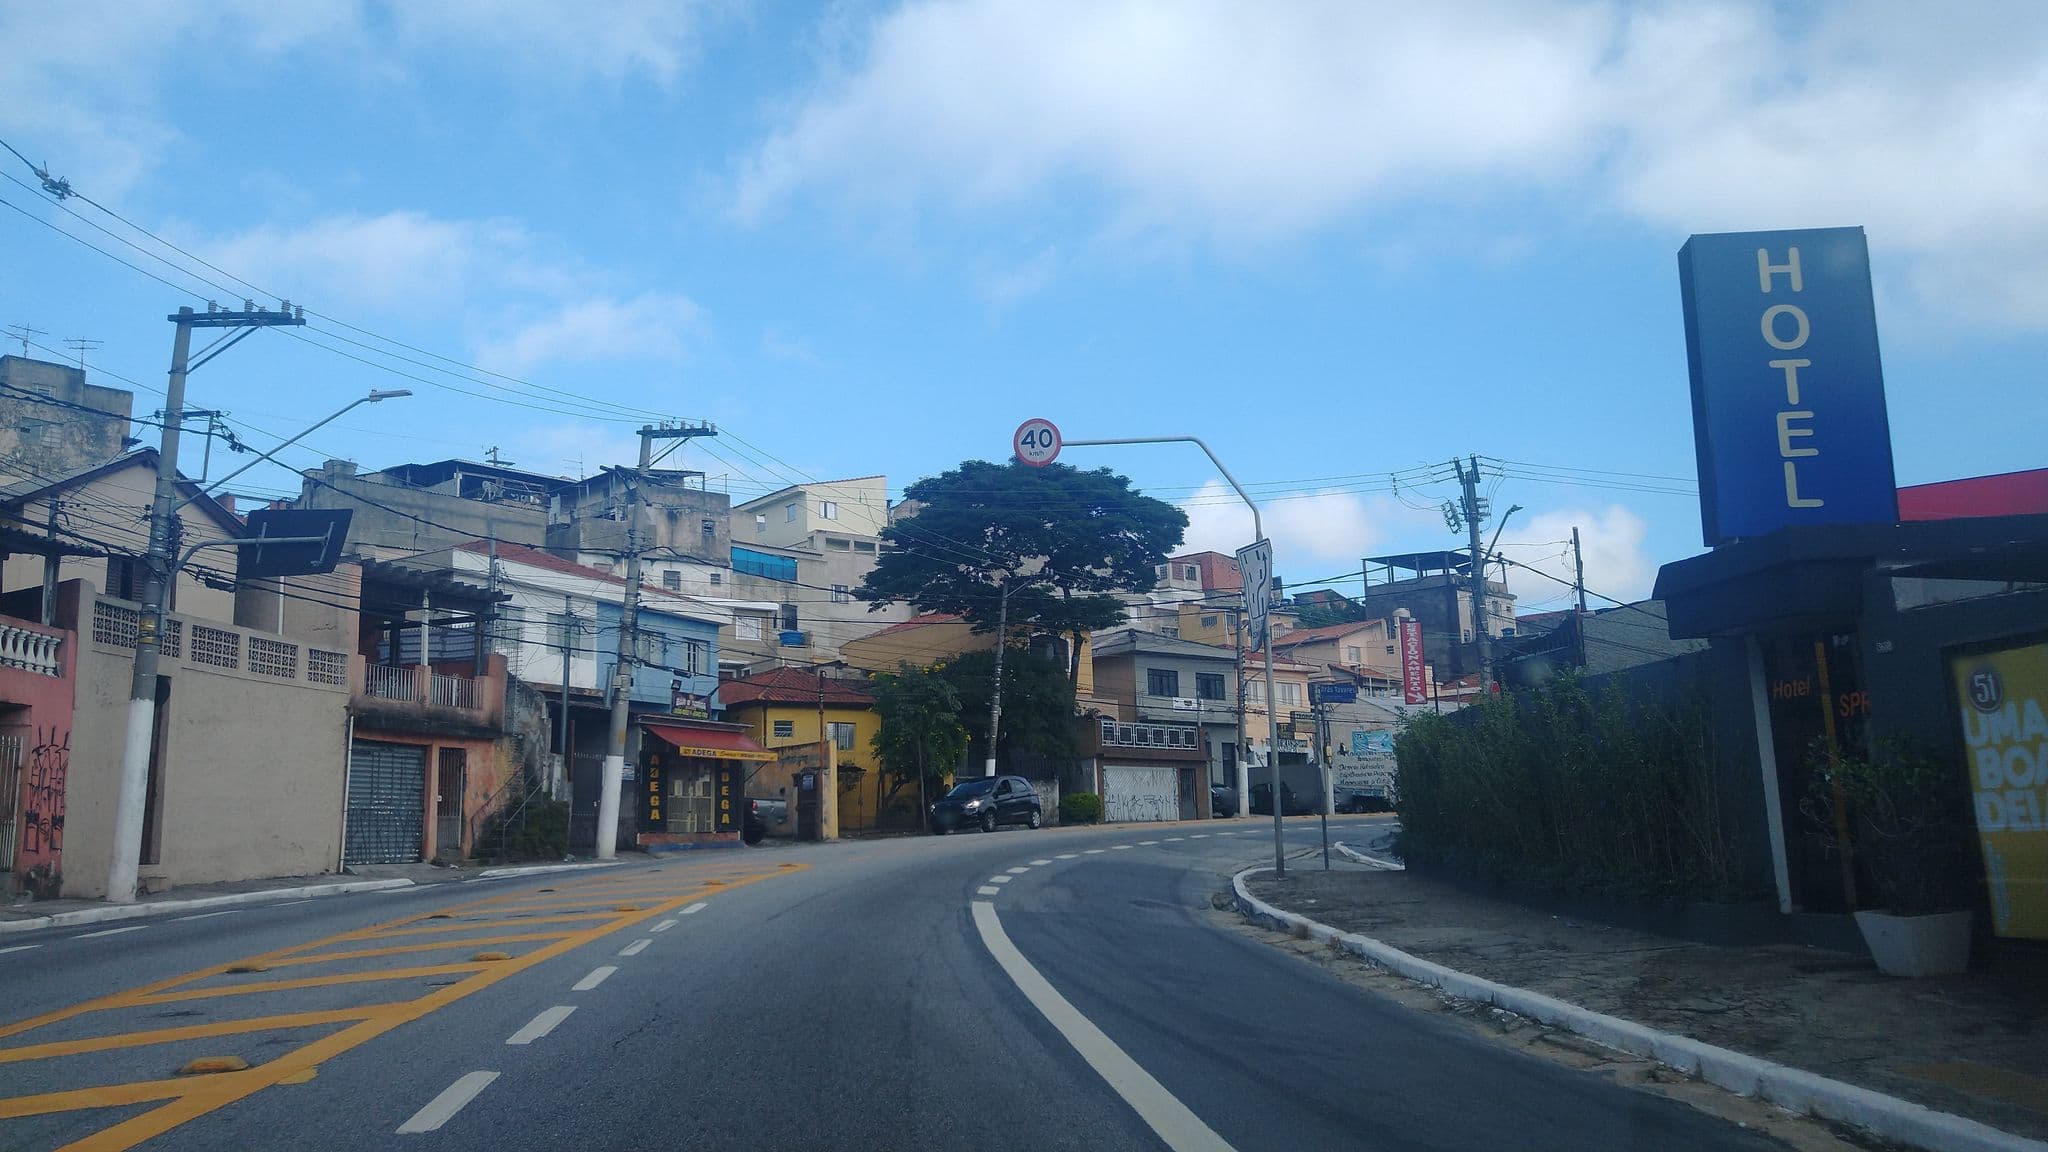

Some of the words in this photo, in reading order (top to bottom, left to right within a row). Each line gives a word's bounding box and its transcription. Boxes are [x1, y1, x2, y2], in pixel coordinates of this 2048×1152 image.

[1757, 245, 1825, 508] HOTEL
[1021, 429, 1053, 448] 40
[1772, 675, 1811, 698] Hotel
[1973, 672, 1997, 703] 51
[1962, 699, 2048, 747] UMA
[692, 748, 717, 757] ADEGA
[649, 754, 661, 820] ADEGA
[720, 759, 731, 824] ADEGA
